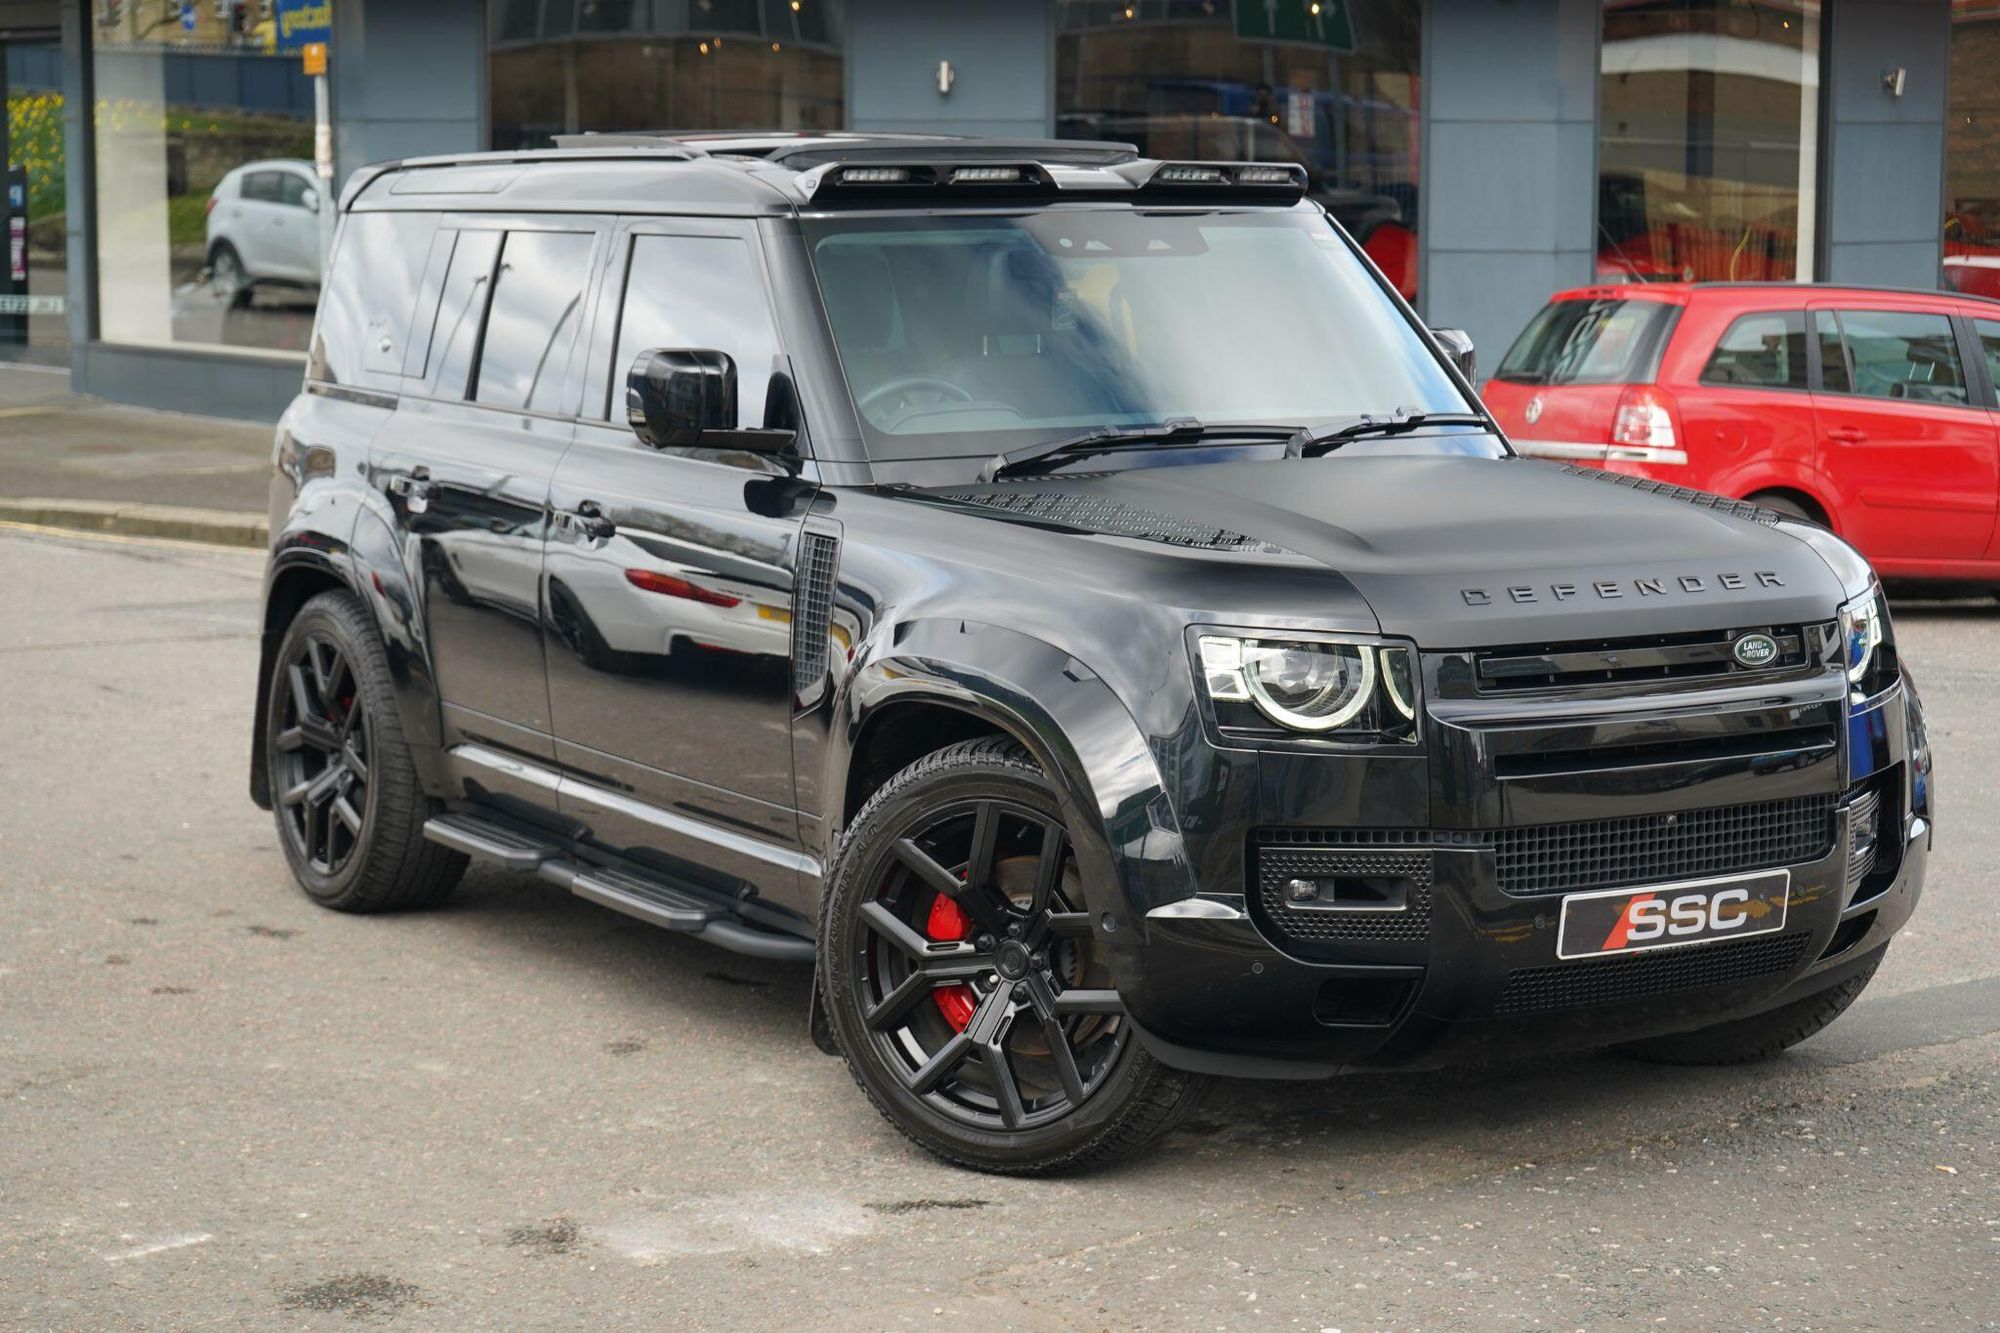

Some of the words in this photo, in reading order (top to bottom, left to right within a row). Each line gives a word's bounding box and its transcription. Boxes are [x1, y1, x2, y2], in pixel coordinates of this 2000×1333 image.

[1461, 571, 1785, 605] DEFENDER
[1743, 641, 1763, 651] LAND
[1746, 648, 1770, 659] ROVER
[1626, 889, 1749, 941] SSC
